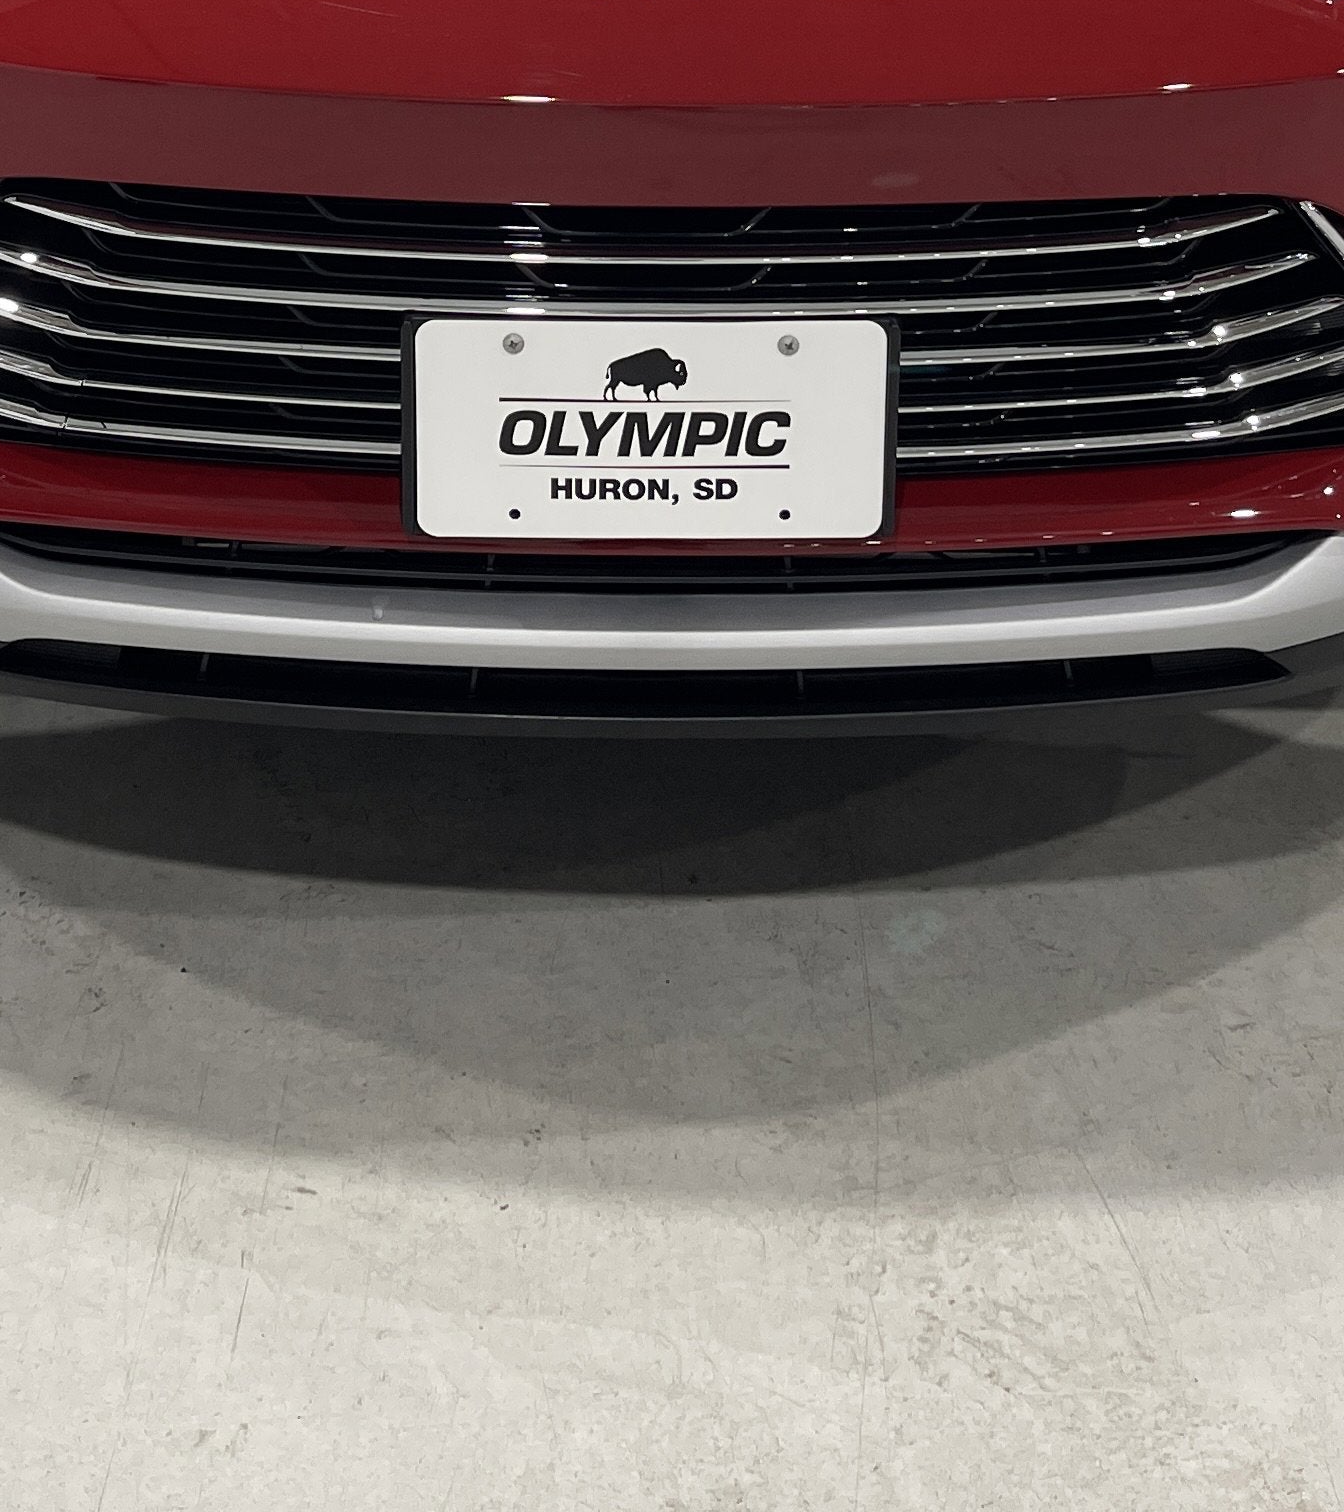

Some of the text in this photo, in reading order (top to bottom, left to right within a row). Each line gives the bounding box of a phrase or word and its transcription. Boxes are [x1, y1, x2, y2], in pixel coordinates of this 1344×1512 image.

[498, 409, 792, 457] OLYMPIC
[550, 477, 739, 505] HURON, SD
